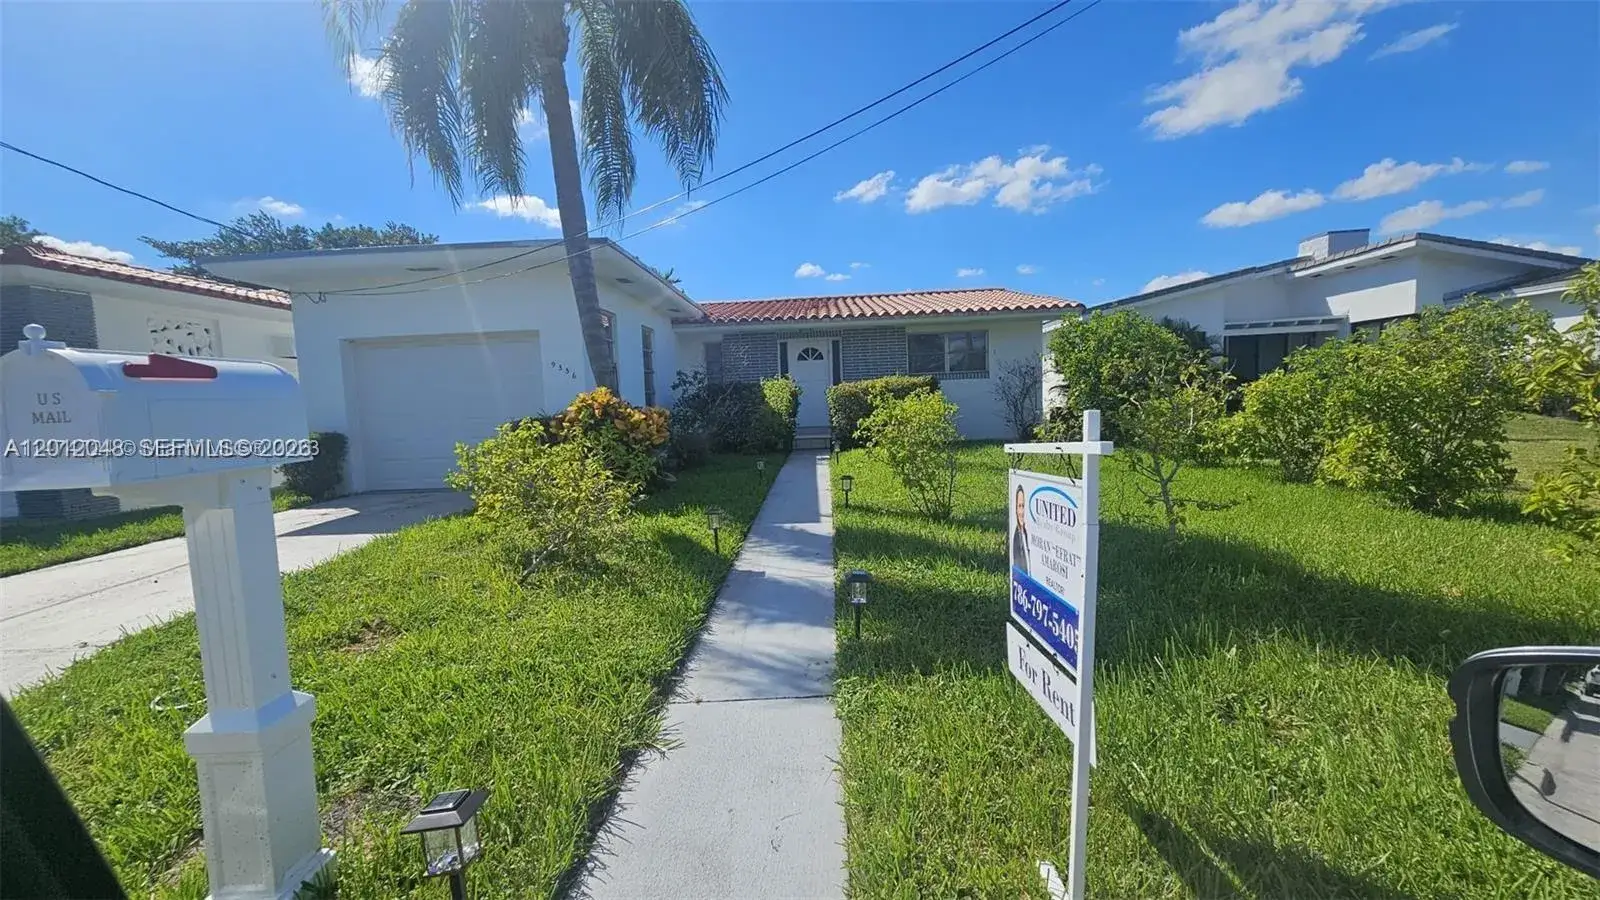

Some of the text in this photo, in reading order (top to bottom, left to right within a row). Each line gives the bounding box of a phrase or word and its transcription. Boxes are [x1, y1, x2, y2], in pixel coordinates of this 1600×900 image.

[37, 392, 61, 406] U S
[31, 410, 71, 424] MAIL
[1035, 498, 1077, 528] UNITED
[1018, 645, 1076, 727] For Rent
